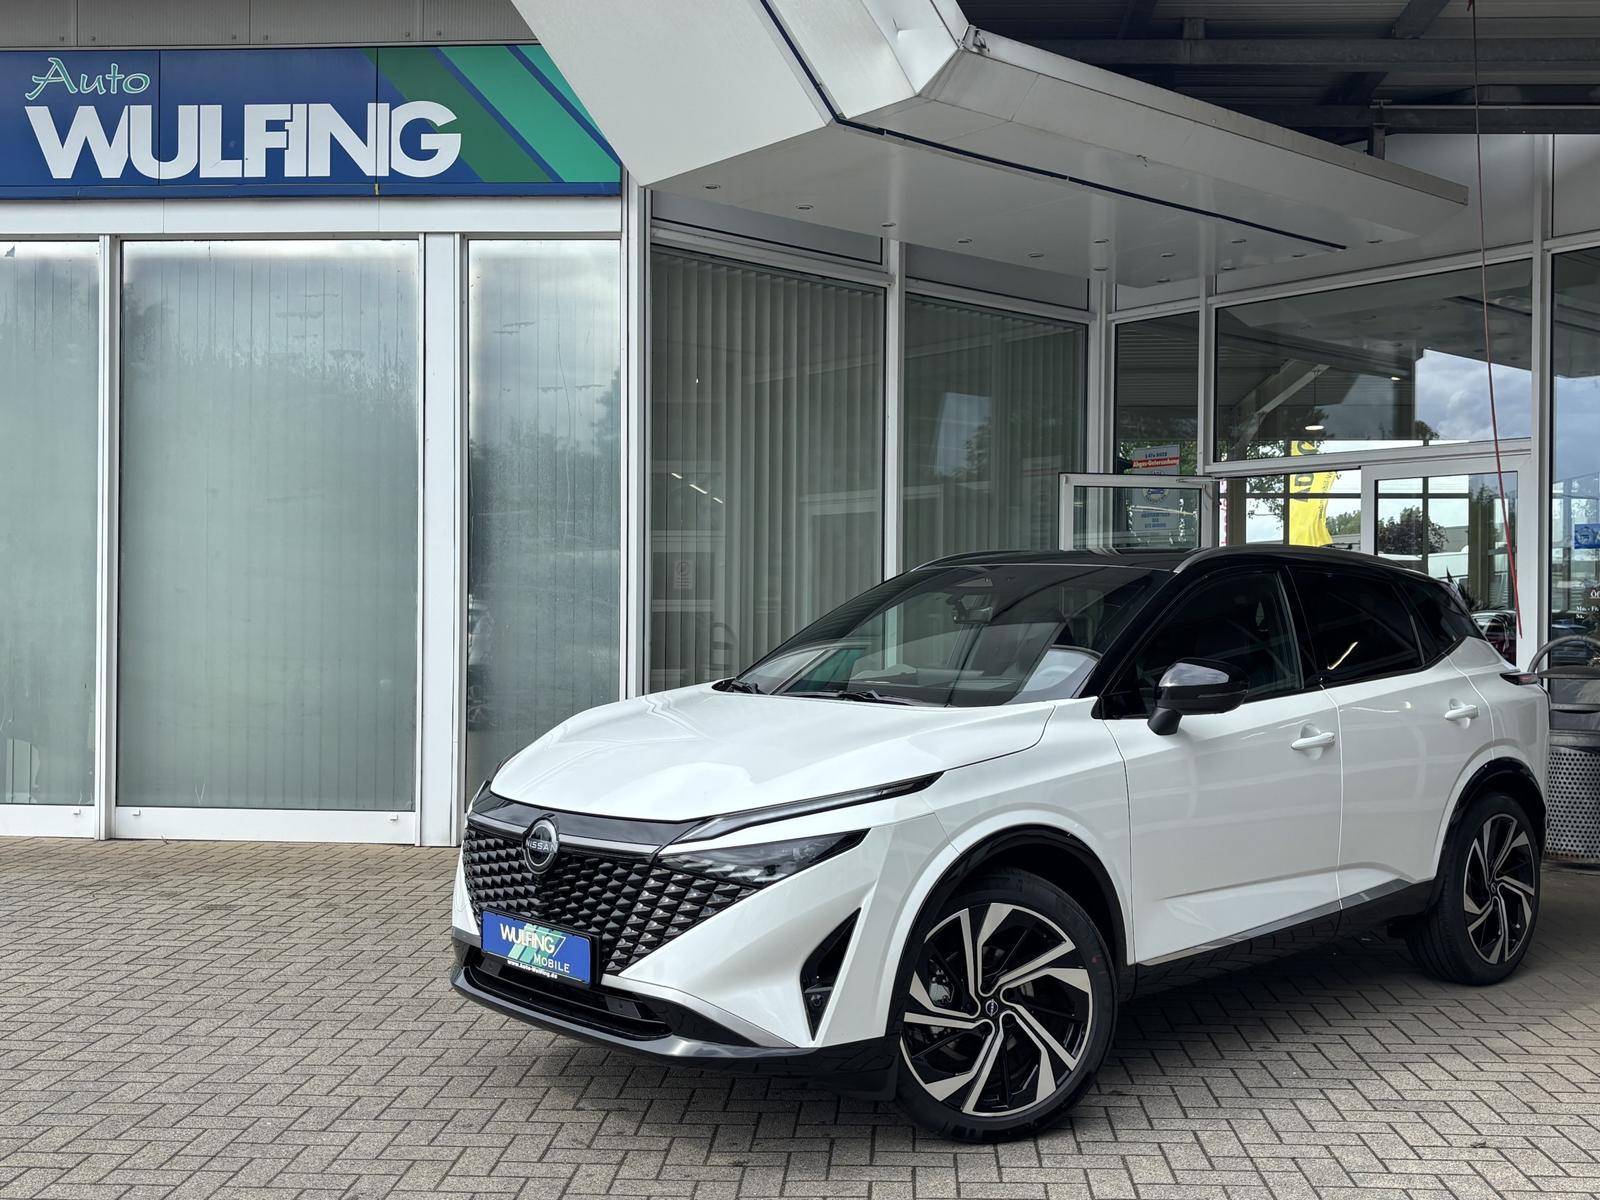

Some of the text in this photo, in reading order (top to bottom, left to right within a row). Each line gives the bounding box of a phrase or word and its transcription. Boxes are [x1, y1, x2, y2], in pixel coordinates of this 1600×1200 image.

[25, 57, 150, 100] Auto
[25, 100, 461, 179] WULFING
[527, 840, 559, 853] NISSAN
[500, 923, 555, 954] WULFING
